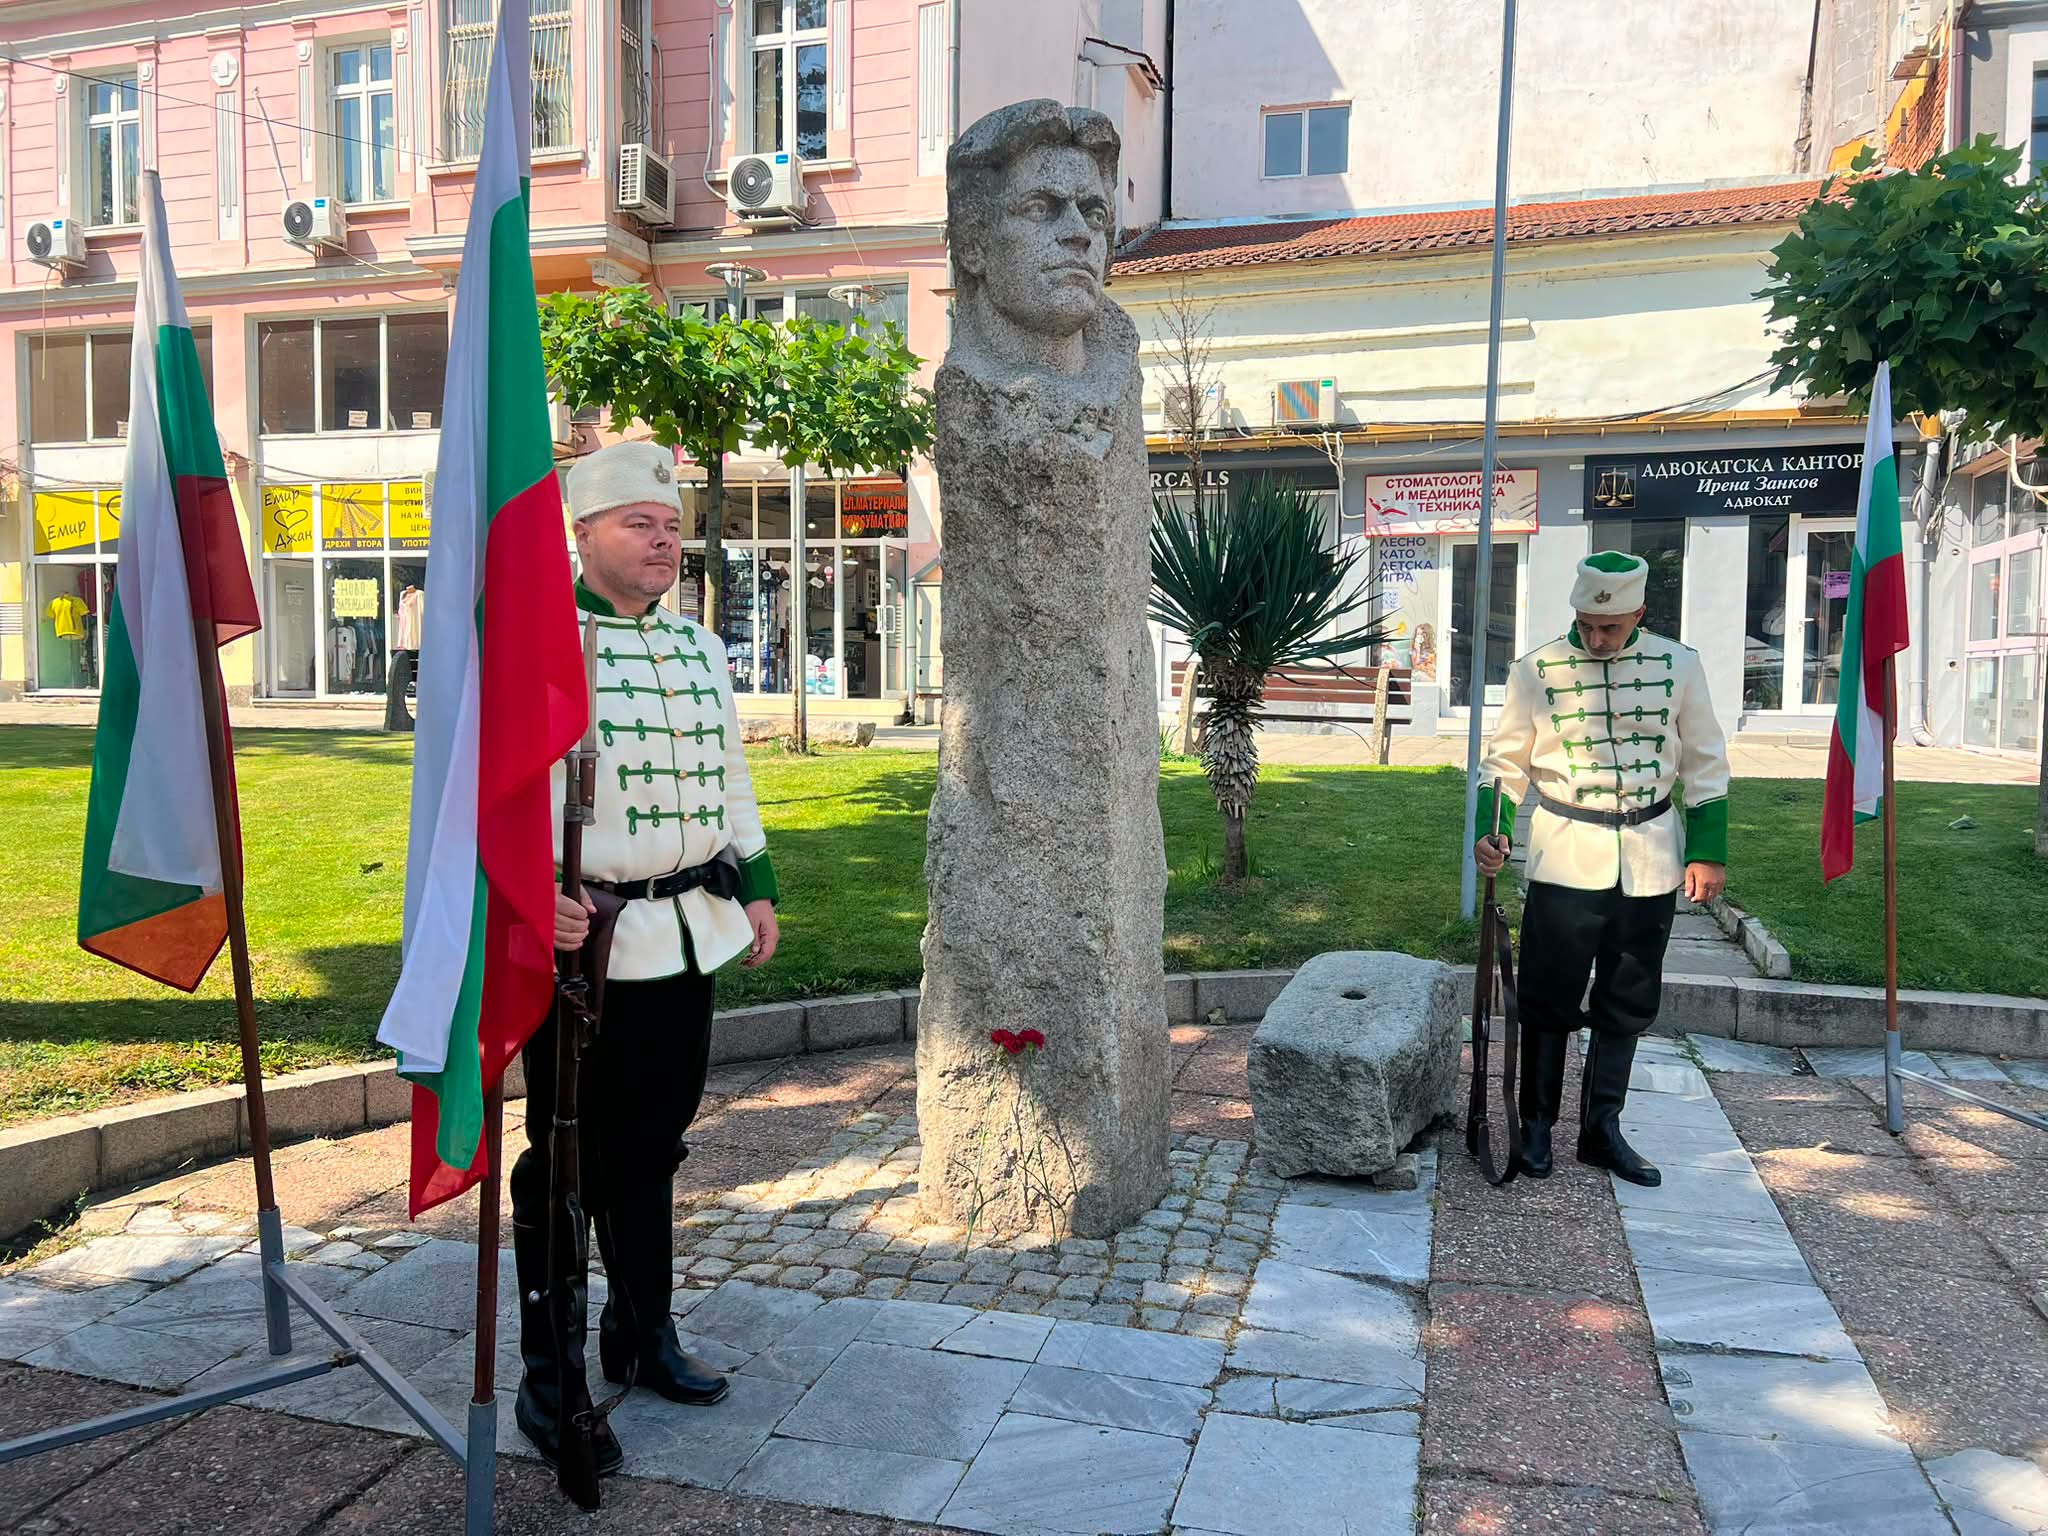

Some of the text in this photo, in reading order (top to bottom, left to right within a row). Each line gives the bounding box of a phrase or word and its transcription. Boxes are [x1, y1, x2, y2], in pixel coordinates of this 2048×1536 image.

[1641, 454, 1864, 480] АДВОКАТСКА КАНТОР
[1150, 470, 1230, 487] RCALS
[1697, 476, 1819, 496] Ирена Занков
[264, 489, 300, 507] Емир
[1395, 491, 1404, 500] И
[1723, 495, 1792, 509] АДВОКАТ
[1417, 501, 1481, 512] ТЕХНИКА
[47, 520, 87, 540] Емир
[325, 540, 351, 549] ДРЕХИ
[357, 540, 383, 548] ВТОРА
[1379, 537, 1426, 548] ЛЕСНО
[1379, 549, 1416, 560] КАТО
[1379, 560, 1433, 573] ДЕТСКА
[1379, 572, 1414, 583] ИГРА
